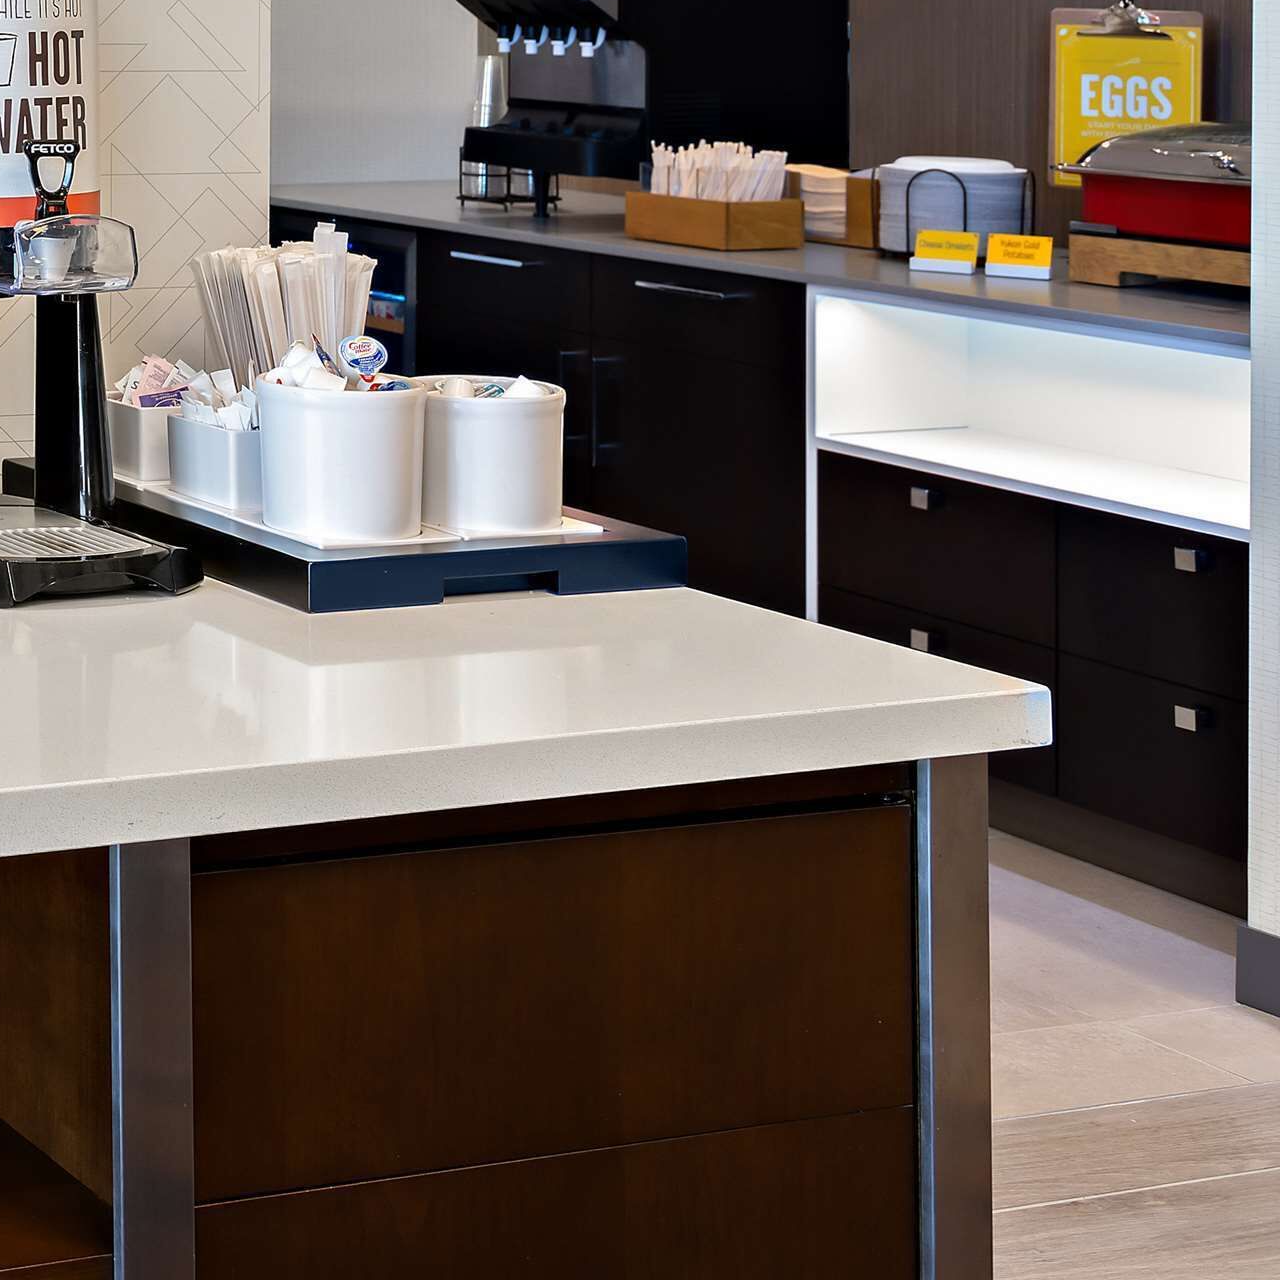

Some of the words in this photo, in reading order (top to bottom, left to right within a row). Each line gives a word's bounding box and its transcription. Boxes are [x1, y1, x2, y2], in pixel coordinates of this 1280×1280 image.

[28, 30, 84, 86] HOT
[1080, 73, 1172, 120] EGGS
[31, 143, 74, 154] FETCO
